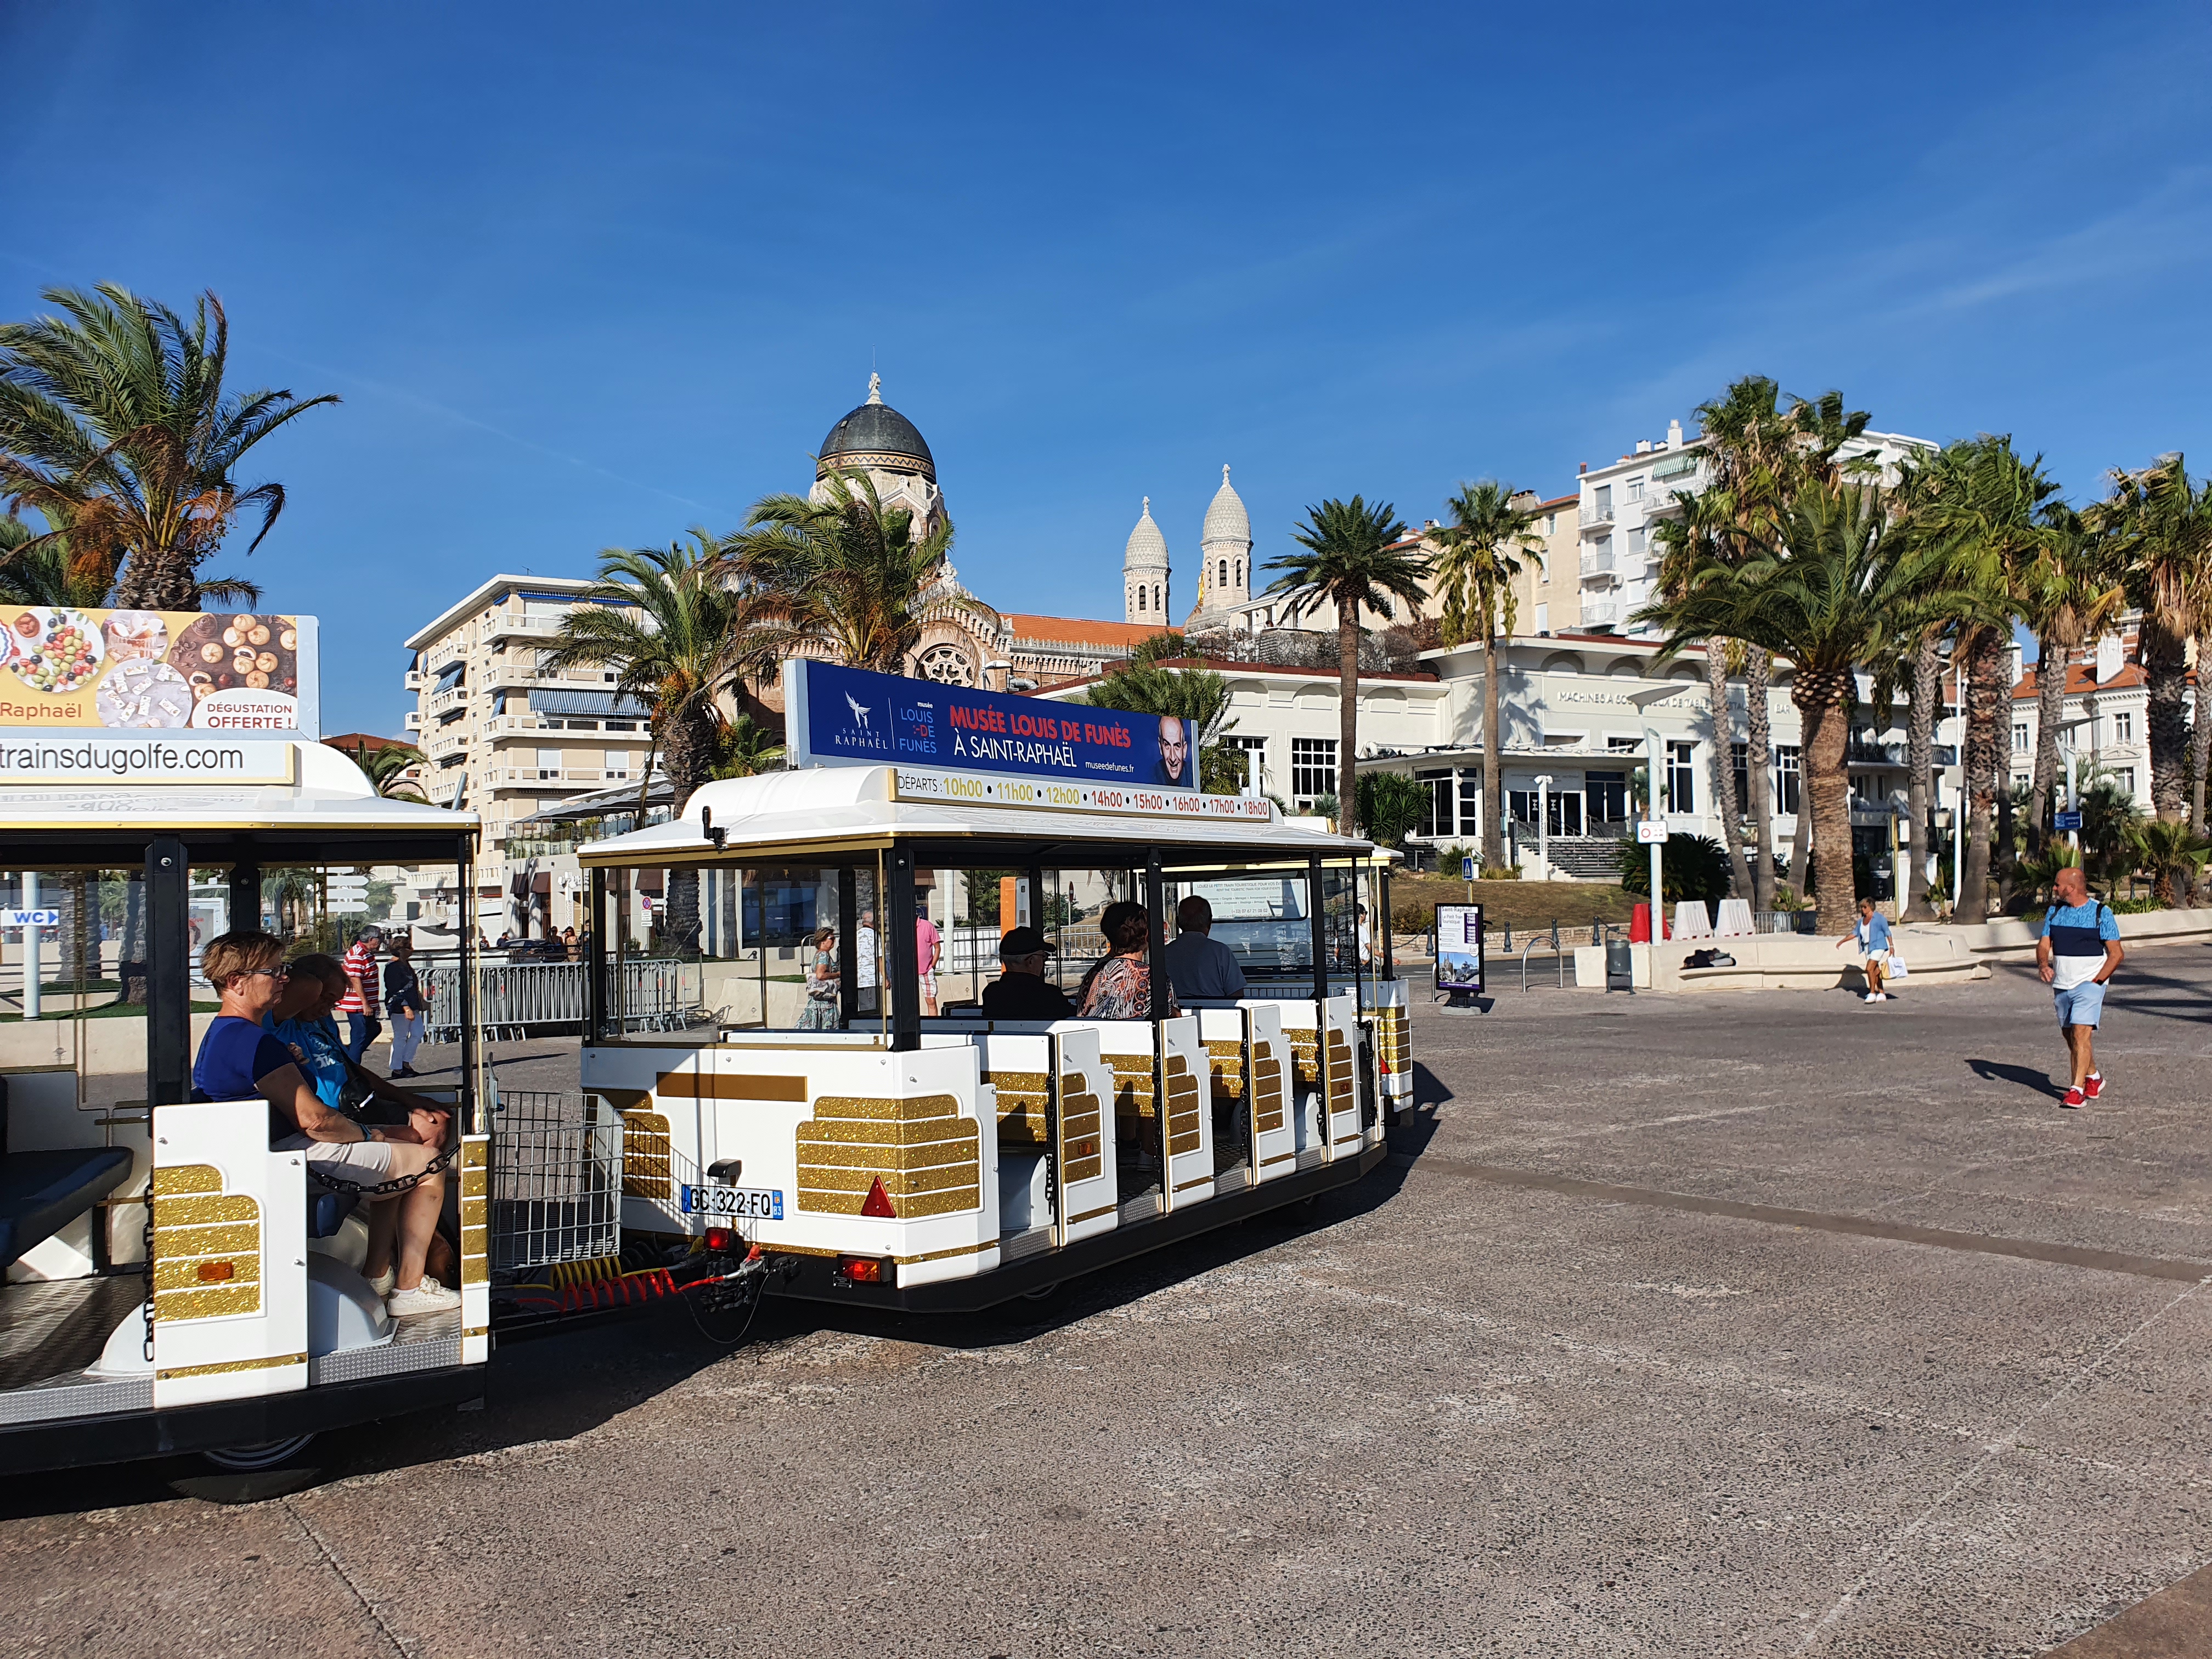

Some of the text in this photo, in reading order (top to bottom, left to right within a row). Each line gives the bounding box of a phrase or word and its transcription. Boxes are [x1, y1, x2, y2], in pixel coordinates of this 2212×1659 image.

[207, 702, 292, 713] DÉGUSTATION
[1558, 691, 1605, 703] MACHINES
[1774, 703, 1791, 714] BAR
[1, 702, 82, 720] Raphaël
[901, 708, 933, 724] LOUIS
[208, 716, 283, 729] OFFERTE
[950, 704, 1131, 748] MUSÉE LOUIS DE FUNÈS
[843, 727, 879, 738] SAINT
[835, 735, 888, 749] RAPHAËL
[900, 738, 937, 754] FUNÈS
[954, 727, 1077, 767] À SAINT-RAPHAËL
[0, 742, 243, 775] trainsdugolfe.com
[1085, 761, 1134, 773] museedefunes.fr
[944, 777, 983, 798] 10h00
[997, 782, 1033, 802] 11h00
[1046, 786, 1080, 805] 12h00
[1092, 790, 1122, 808] 14h00
[1133, 793, 1163, 810] 15h00
[1173, 796, 1200, 812] 16h00
[1209, 799, 1234, 814] 17h00
[1244, 800, 1267, 815] 18h00
[14, 912, 44, 923] WC
[691, 1189, 770, 1216] GC-322-FQ
[774, 1205, 782, 1216] 83
